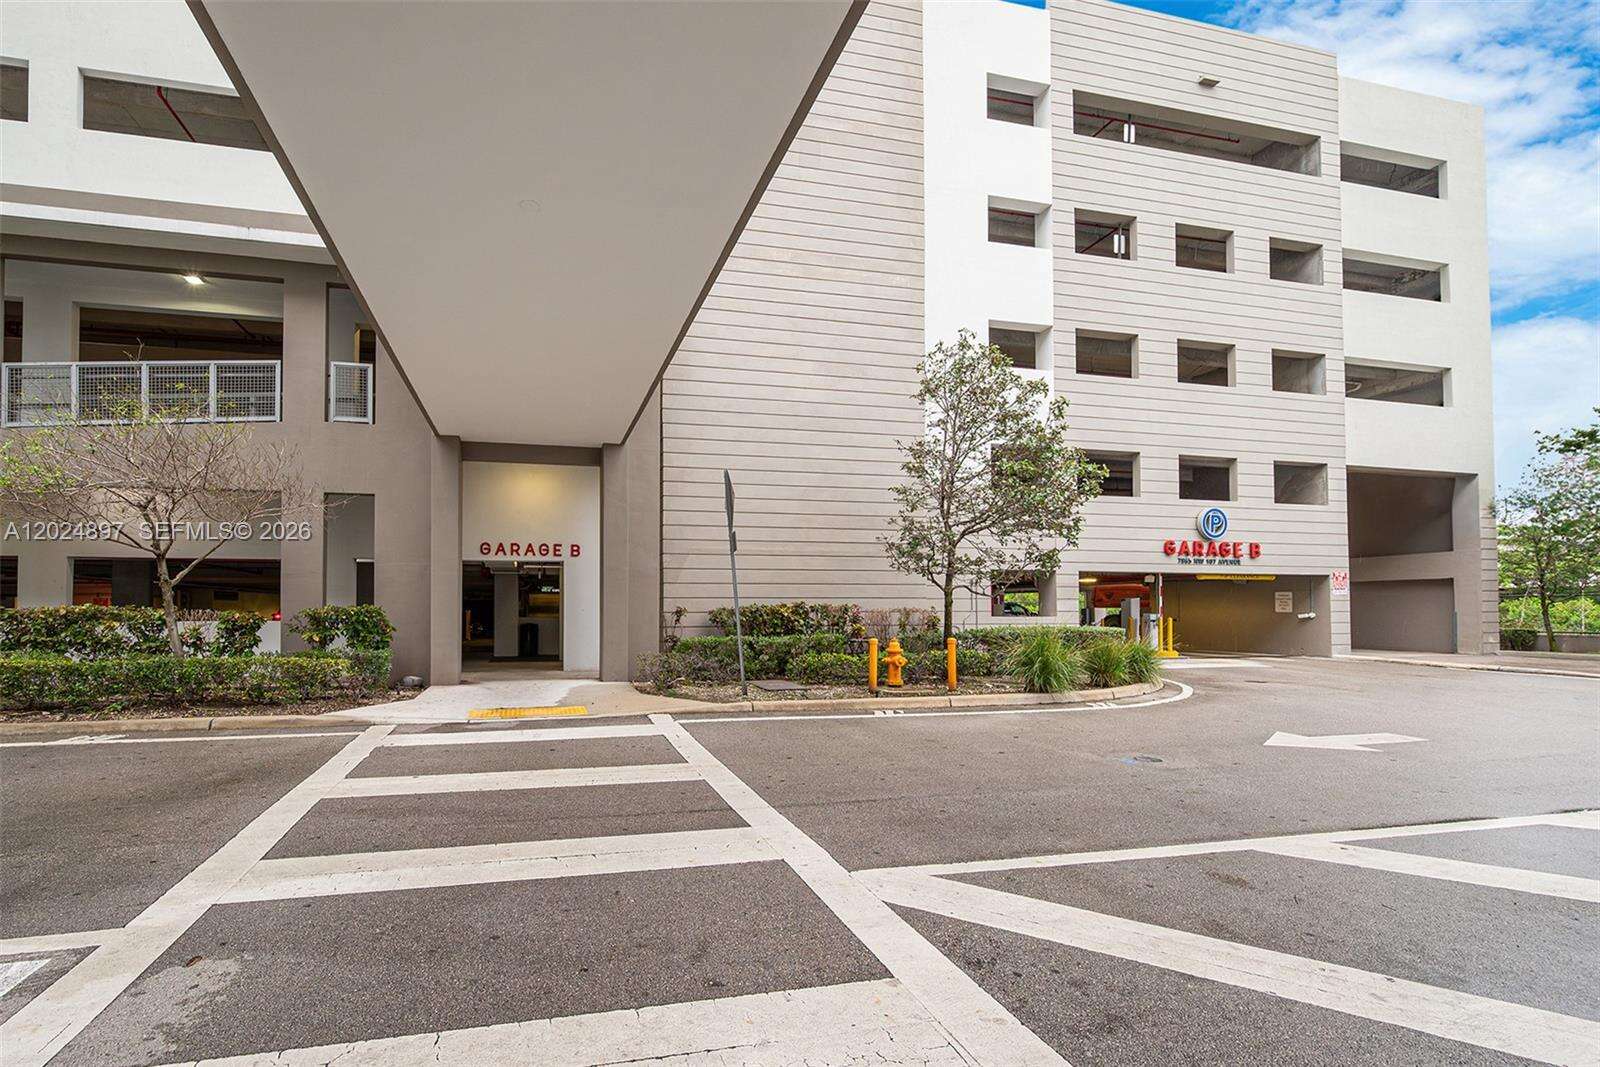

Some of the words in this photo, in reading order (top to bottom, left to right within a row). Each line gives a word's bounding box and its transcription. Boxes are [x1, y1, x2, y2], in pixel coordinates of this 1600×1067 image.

[480, 542, 562, 557] GARAGE
[570, 544, 581, 557] B
[1163, 540, 1244, 558] GARAGE
[1249, 542, 1261, 559] B
